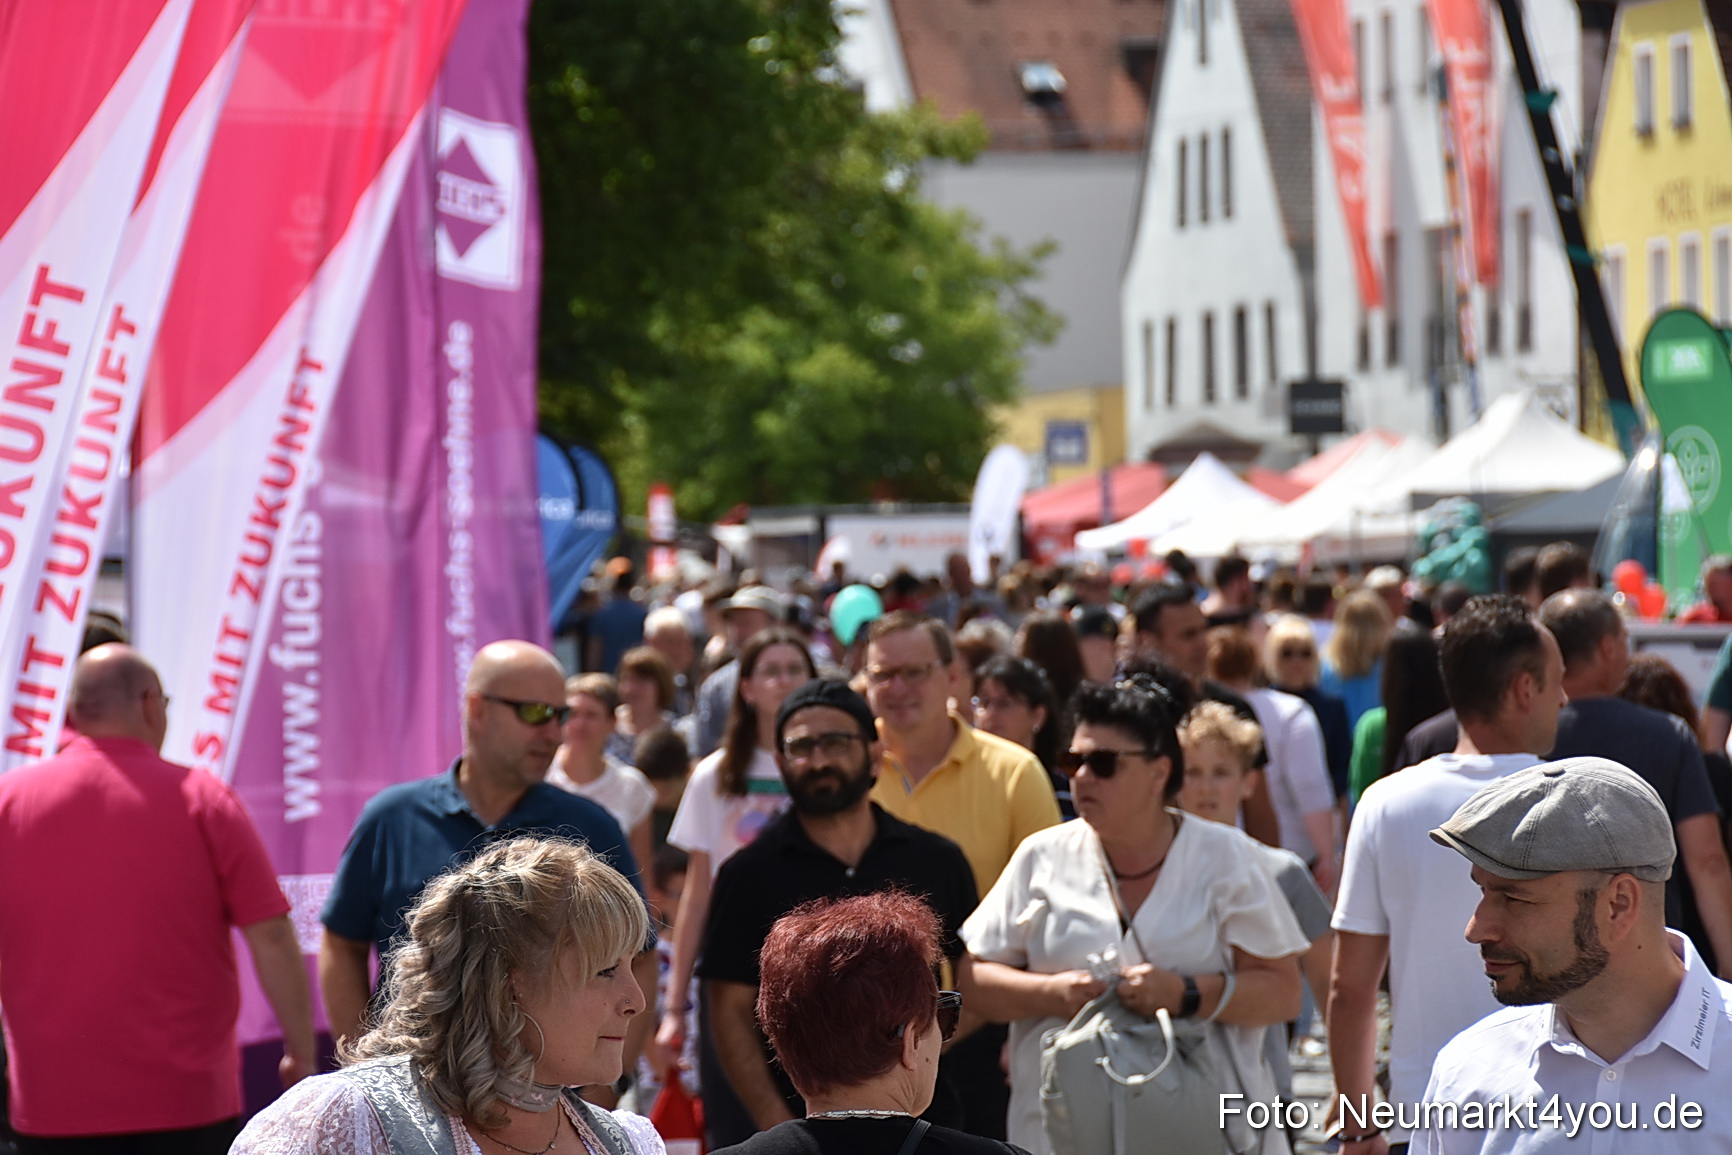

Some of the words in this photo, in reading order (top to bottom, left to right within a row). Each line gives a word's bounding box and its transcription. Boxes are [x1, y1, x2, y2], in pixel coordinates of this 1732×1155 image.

[0, 264, 87, 602] KUNFT
[34, 304, 137, 622] ZUKUNFT
[204, 615, 250, 716] MIT
[230, 346, 324, 604] ZUKUNFT
[4, 634, 65, 757] MIT
[1701, 986, 1711, 998] IT
